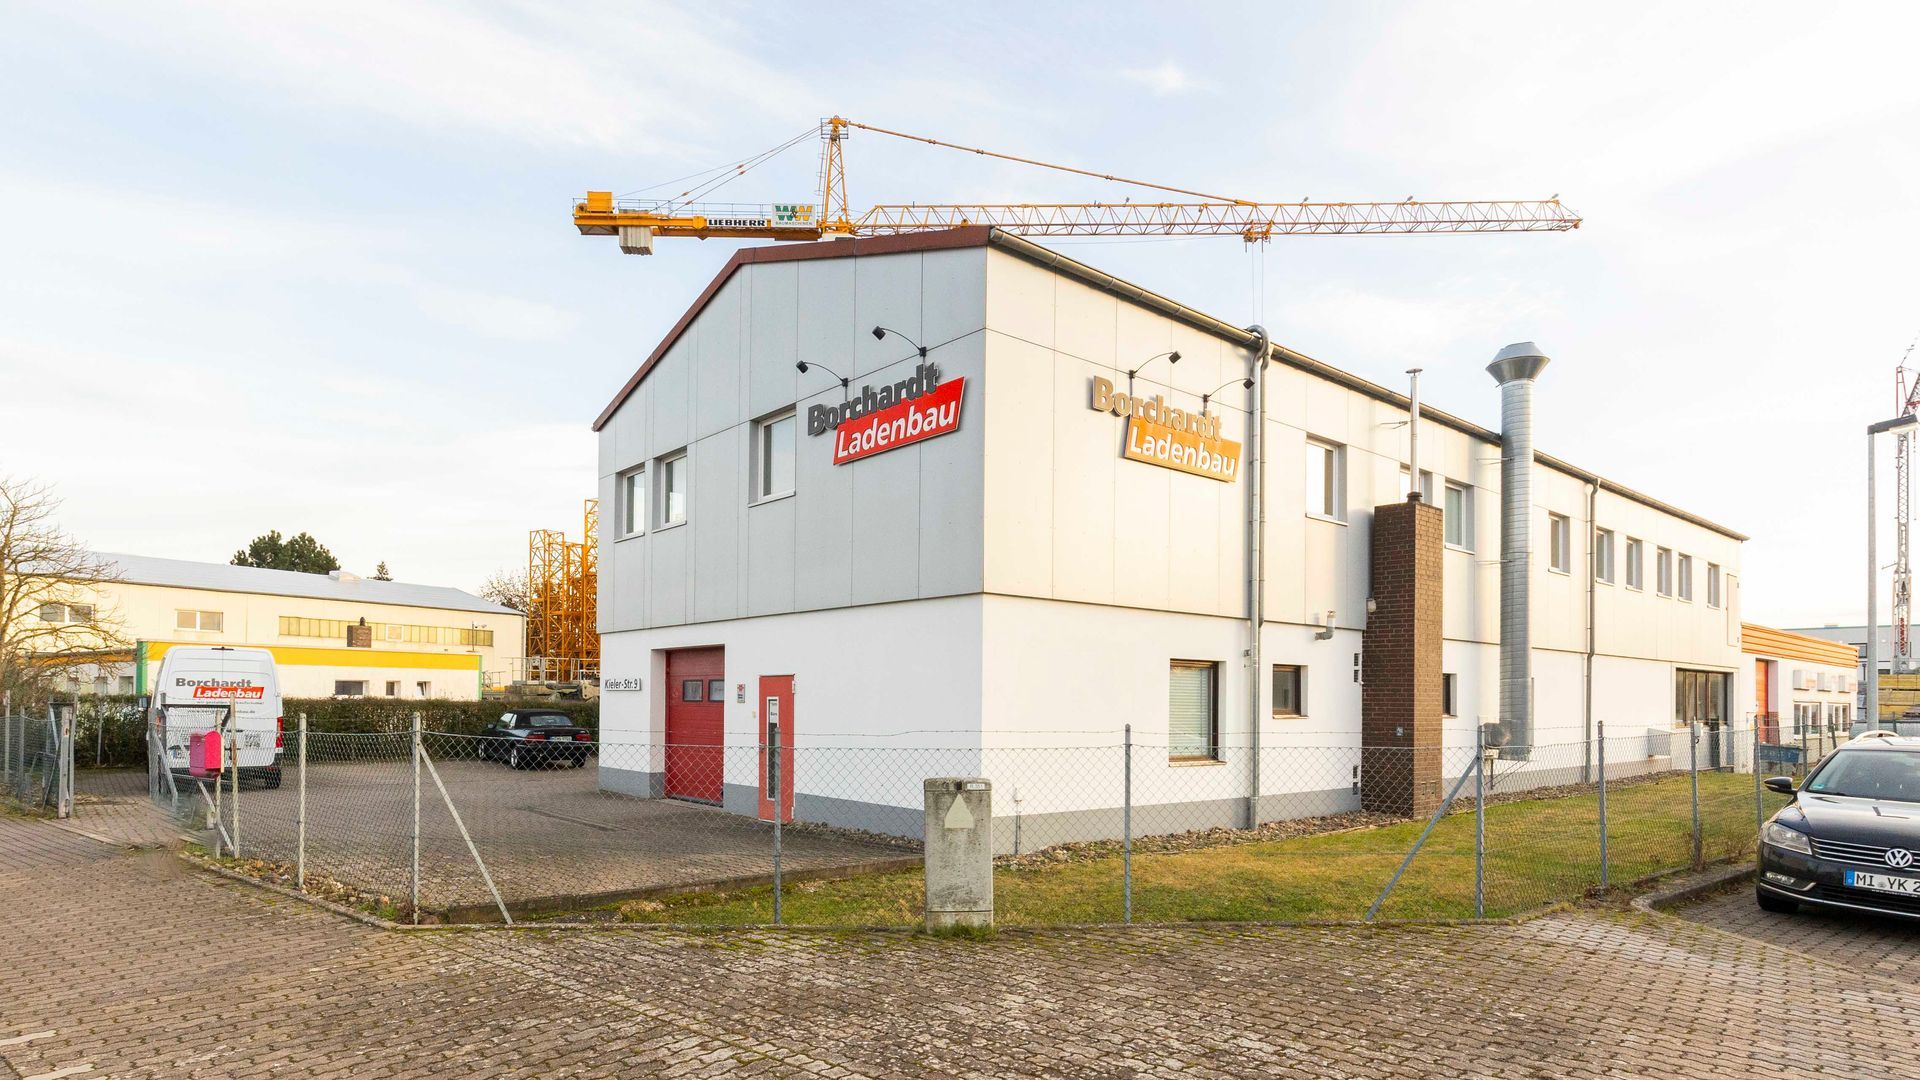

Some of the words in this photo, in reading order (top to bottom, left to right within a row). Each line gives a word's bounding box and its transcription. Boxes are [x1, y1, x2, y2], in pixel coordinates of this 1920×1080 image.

[708, 219, 766, 227] LIEBHERR
[808, 362, 939, 436] Borchardt
[1093, 375, 1222, 442] Borchardt
[837, 401, 956, 458] Ladenbau
[1130, 426, 1236, 477] Ladenbau
[175, 677, 252, 687] Borchardt
[1856, 873, 1875, 887] MI
[1887, 877, 1908, 892] YK
